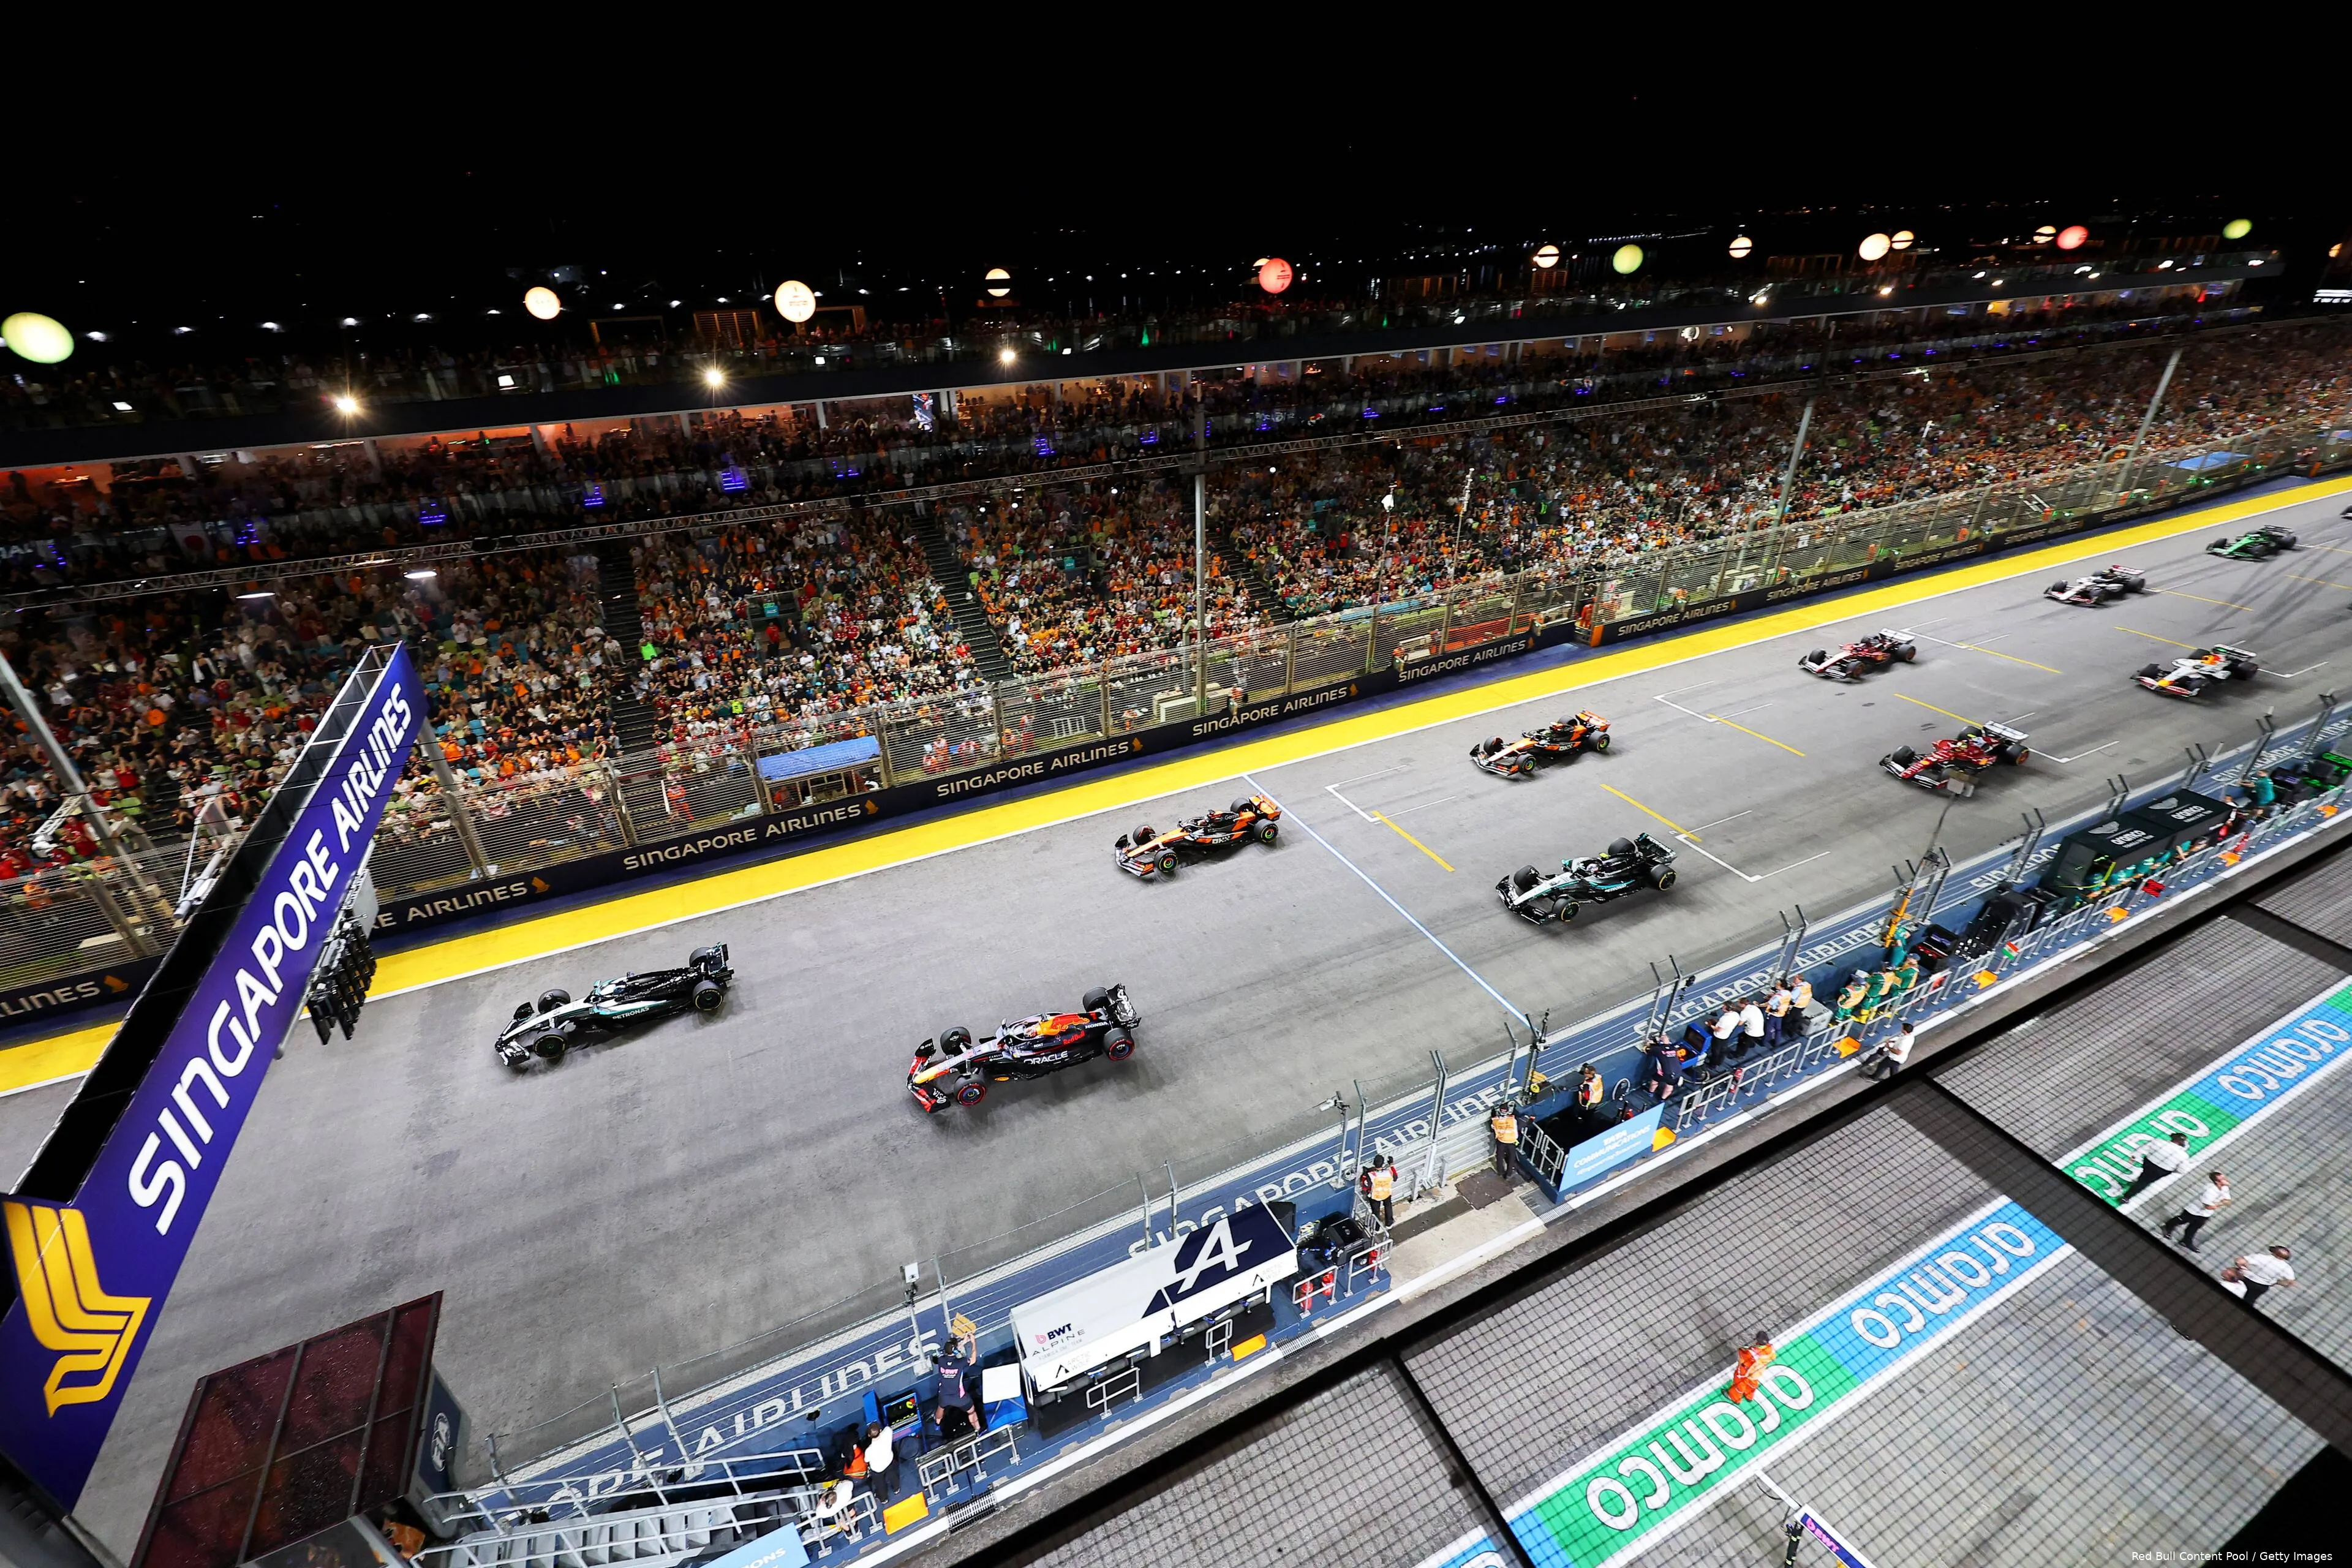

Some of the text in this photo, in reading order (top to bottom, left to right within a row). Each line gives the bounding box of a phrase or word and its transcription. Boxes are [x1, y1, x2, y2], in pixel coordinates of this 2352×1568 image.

[1618, 600, 1730, 636] SINGAPORE AIRLINES
[1398, 639, 1526, 682] SINGAPORE AIRLINES
[1193, 688, 1347, 736] SINGAPORE AIRLINES
[937, 741, 1129, 797] SINGAPORE AIRLINES
[2171, 805, 2205, 820] aramco
[624, 804, 861, 870] SINGAPORE AIRLINES
[2111, 830, 2146, 845] aramco
[407, 881, 528, 922] AIRLINES
[128, 682, 413, 1236] SINGAPORE AIRLINES
[612, 1006, 650, 1020] PETRONAS
[1085, 1020, 1109, 1029] HONDA
[1074, 1030, 1086, 1041] Bull
[1023, 1050, 1068, 1065] ORACLE
[2216, 1018, 2351, 1101] aramco
[1574, 1125, 1652, 1169] COMMUNICATIONS
[1850, 1222, 2036, 1350] aramco
[1032, 1329, 1085, 1357] ALPINE
[1047, 1323, 1072, 1340] BWT
